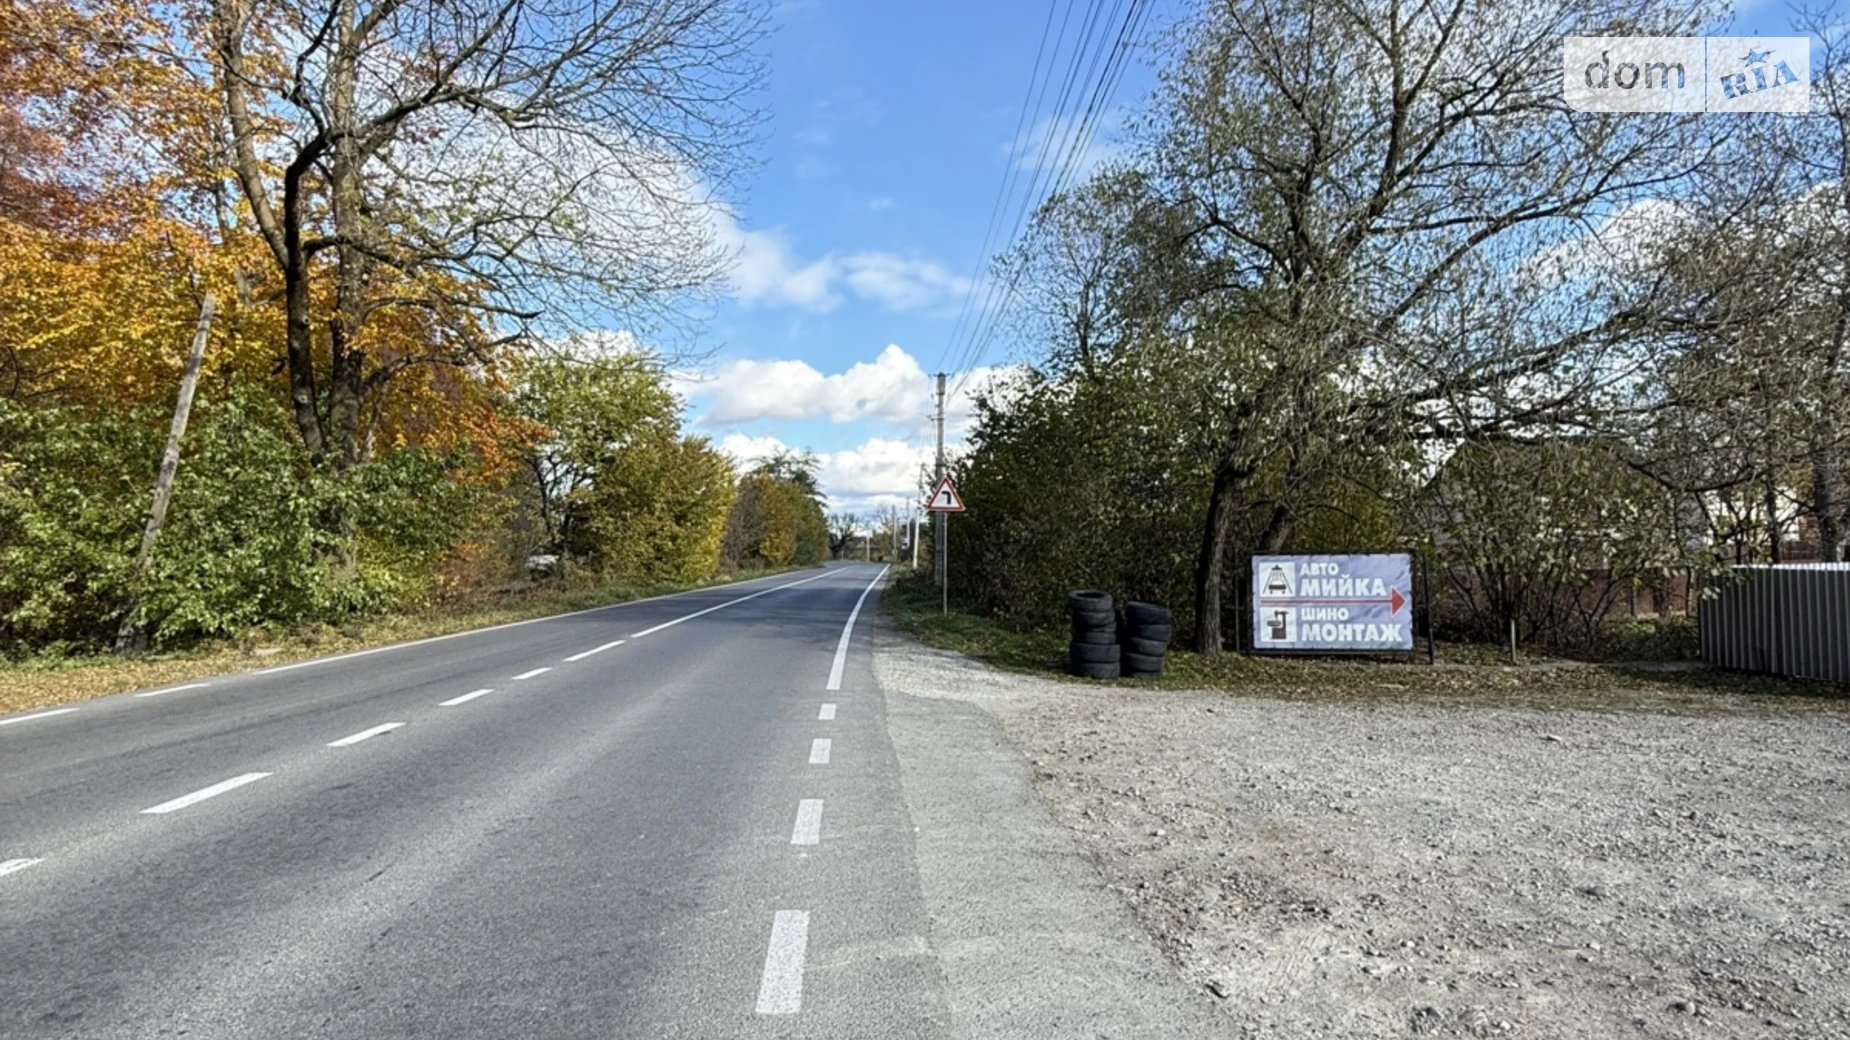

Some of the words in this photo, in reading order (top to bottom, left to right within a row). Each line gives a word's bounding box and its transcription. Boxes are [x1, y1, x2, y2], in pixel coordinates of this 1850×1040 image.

[1300, 563, 1339, 575] АВТО
[1300, 574, 1387, 596] МИЙКА
[1301, 608, 1349, 620] ШИНО
[1302, 624, 1402, 641] МОНТАЖ
